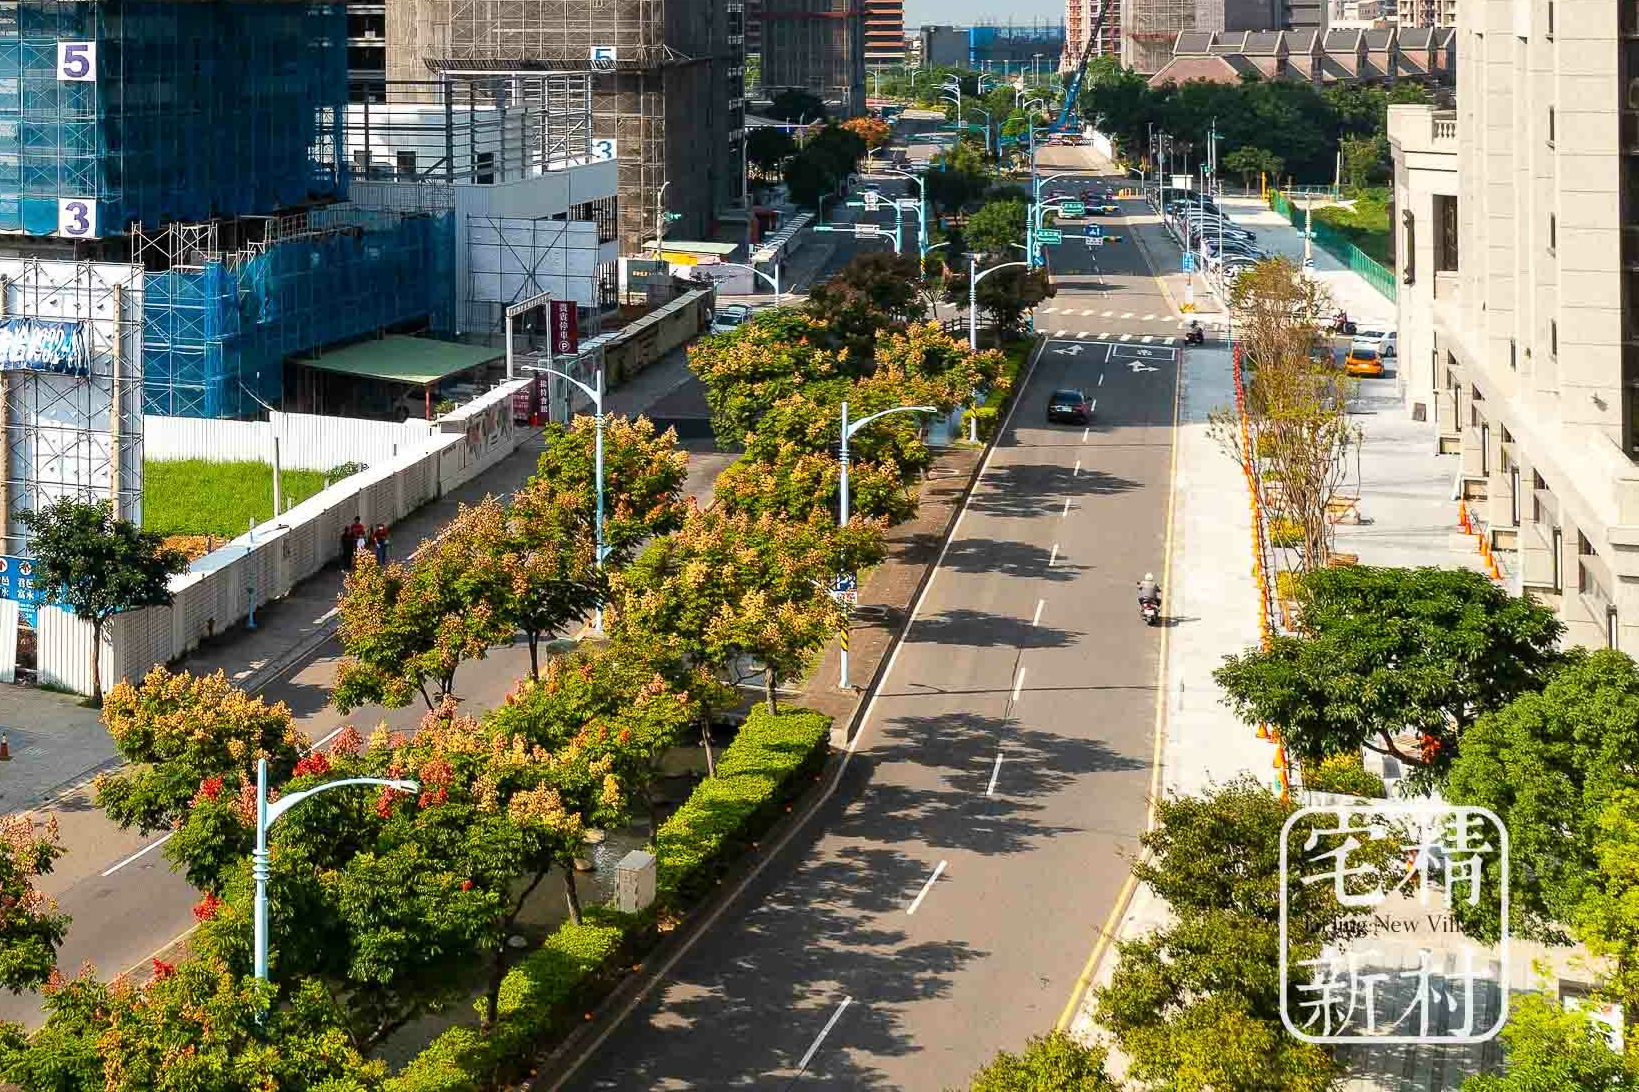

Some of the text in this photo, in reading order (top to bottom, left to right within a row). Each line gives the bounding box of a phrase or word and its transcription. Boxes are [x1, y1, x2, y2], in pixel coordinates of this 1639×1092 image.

[63, 44, 90, 78] 5
[595, 140, 612, 159] 3
[64, 201, 90, 235] 3
